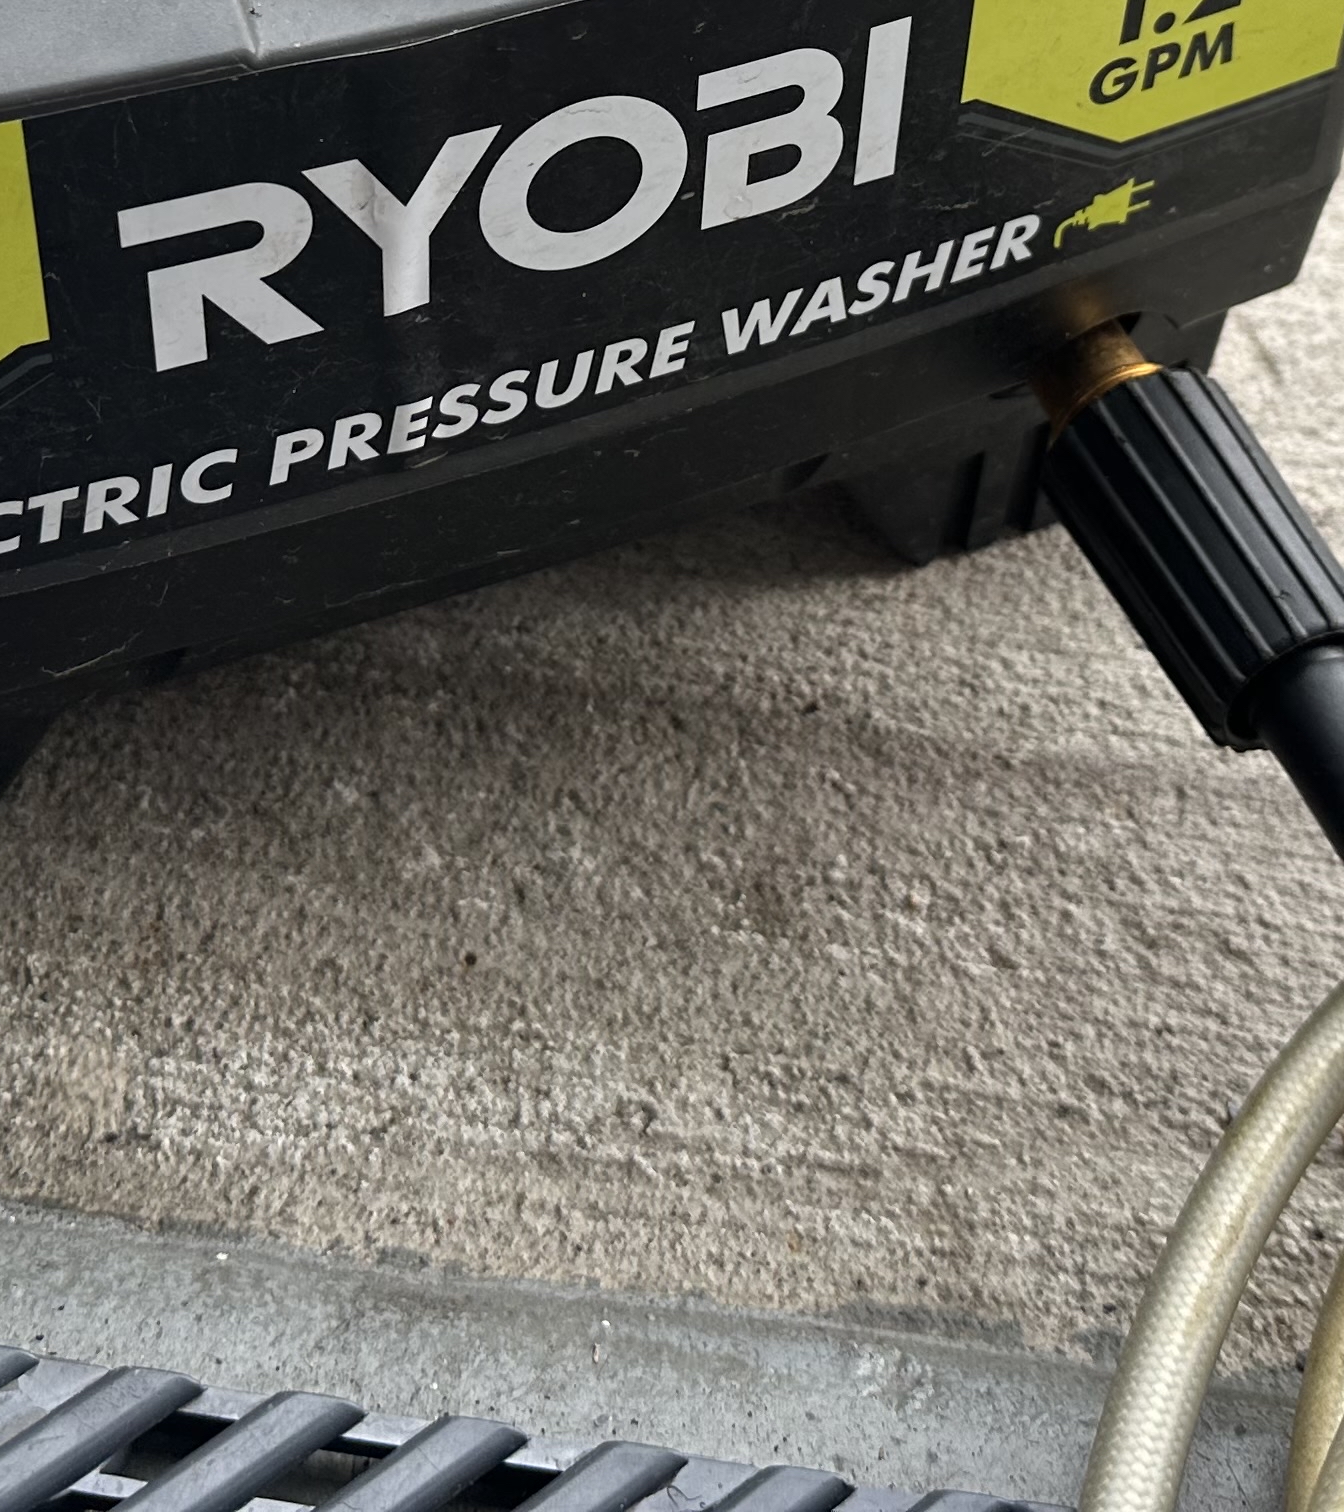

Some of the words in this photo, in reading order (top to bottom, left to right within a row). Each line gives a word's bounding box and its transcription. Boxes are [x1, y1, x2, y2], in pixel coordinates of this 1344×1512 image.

[117, 16, 913, 373] RYOBI
[1087, 22, 1236, 106] GPM
[268, 320, 695, 486] PRESSURE
[719, 214, 1041, 358] WASHER
